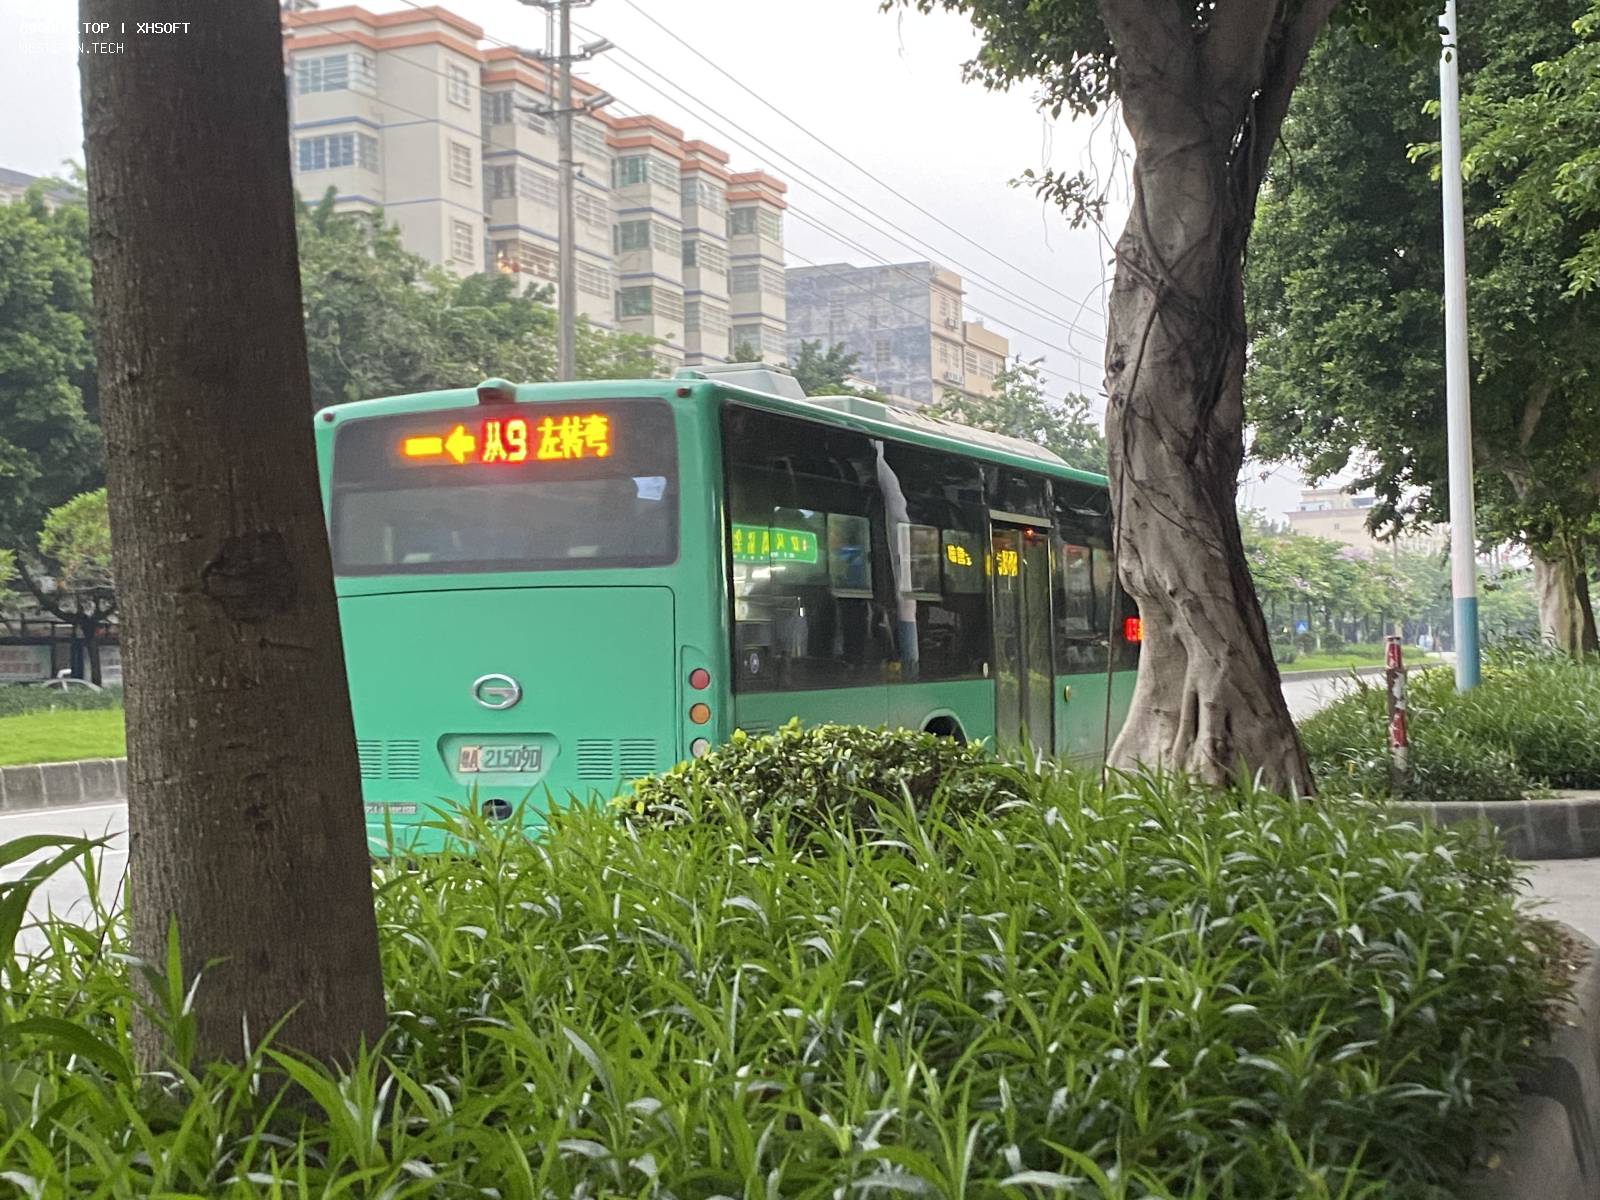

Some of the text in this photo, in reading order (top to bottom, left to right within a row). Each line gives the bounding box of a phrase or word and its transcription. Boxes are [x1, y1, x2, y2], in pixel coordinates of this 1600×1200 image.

[482, 413, 610, 463] 从9 左转弯
